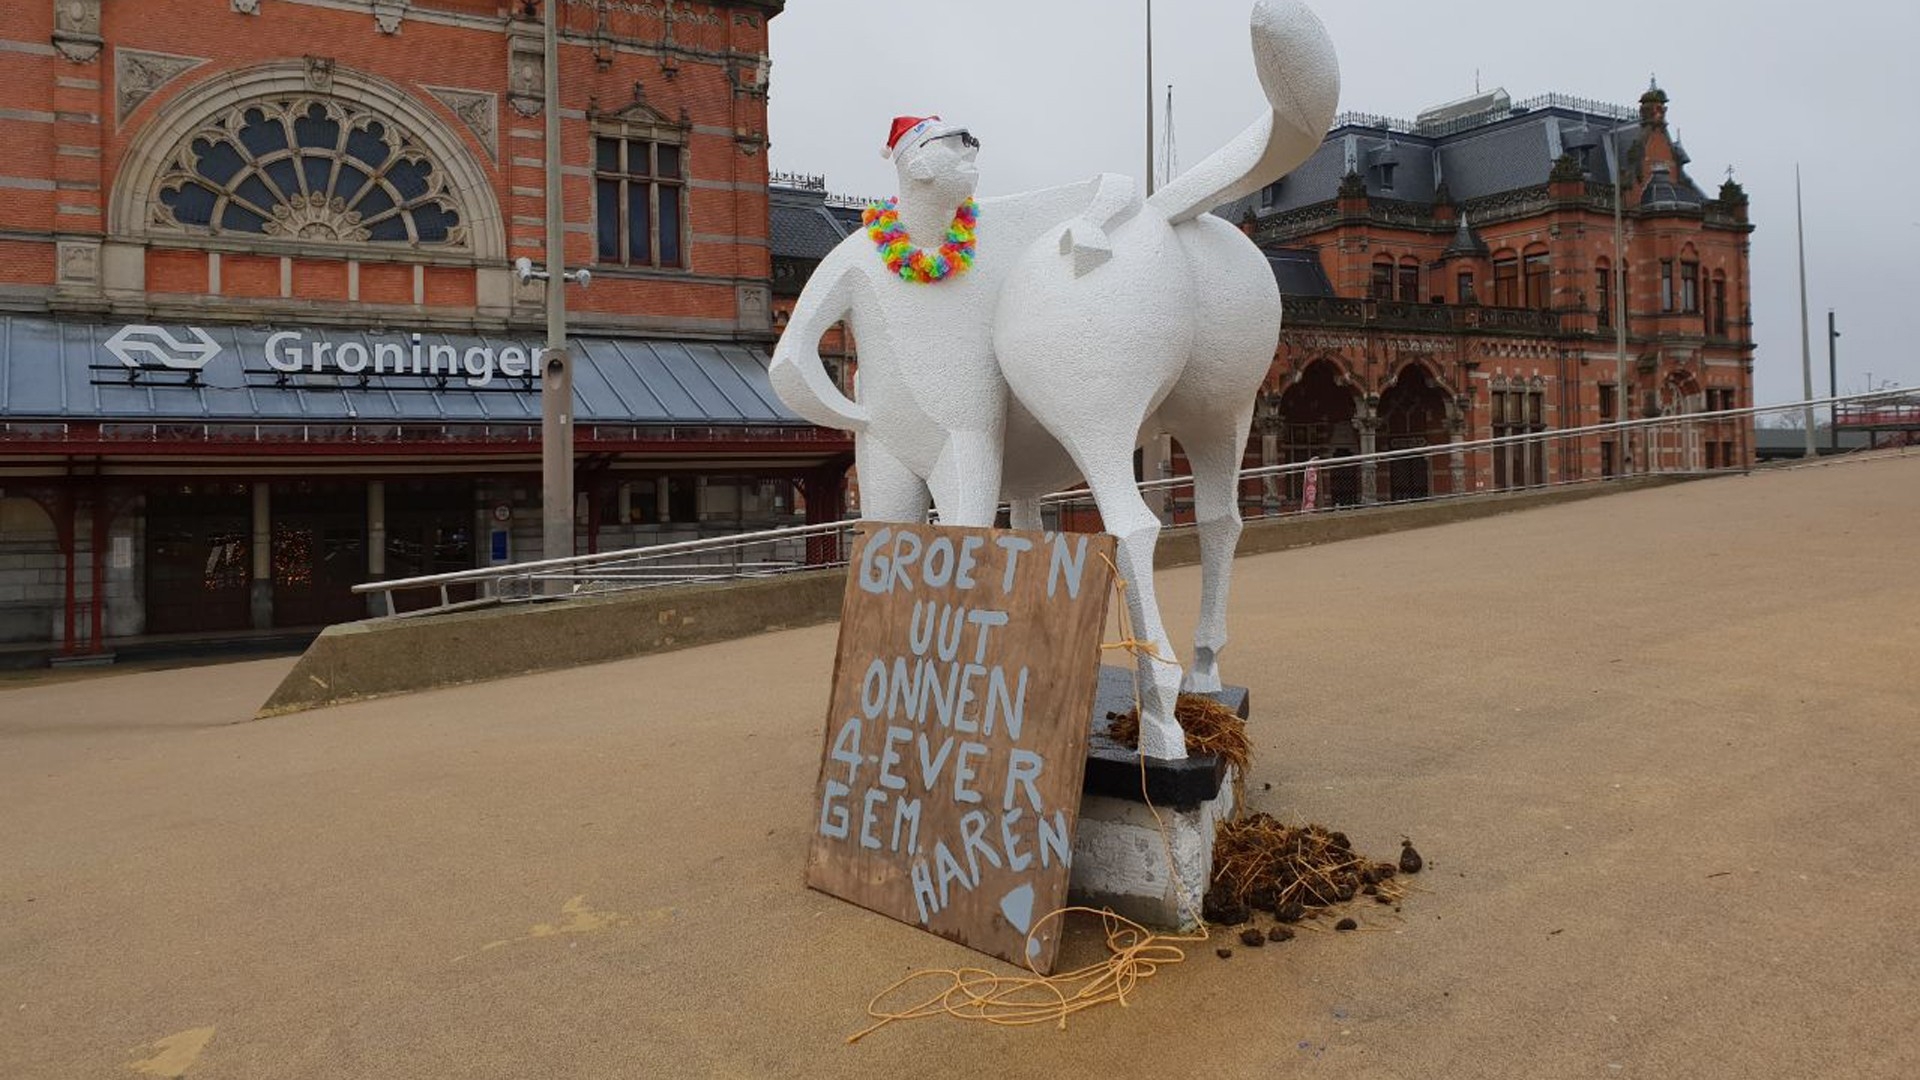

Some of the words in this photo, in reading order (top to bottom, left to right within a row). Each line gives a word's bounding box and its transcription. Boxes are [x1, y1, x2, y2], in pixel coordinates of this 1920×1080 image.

[860, 529, 1087, 598] GROET'N
[909, 601, 1009, 665] UUT
[861, 656, 1029, 741] ONNEN
[911, 808, 1072, 922] HAREN
